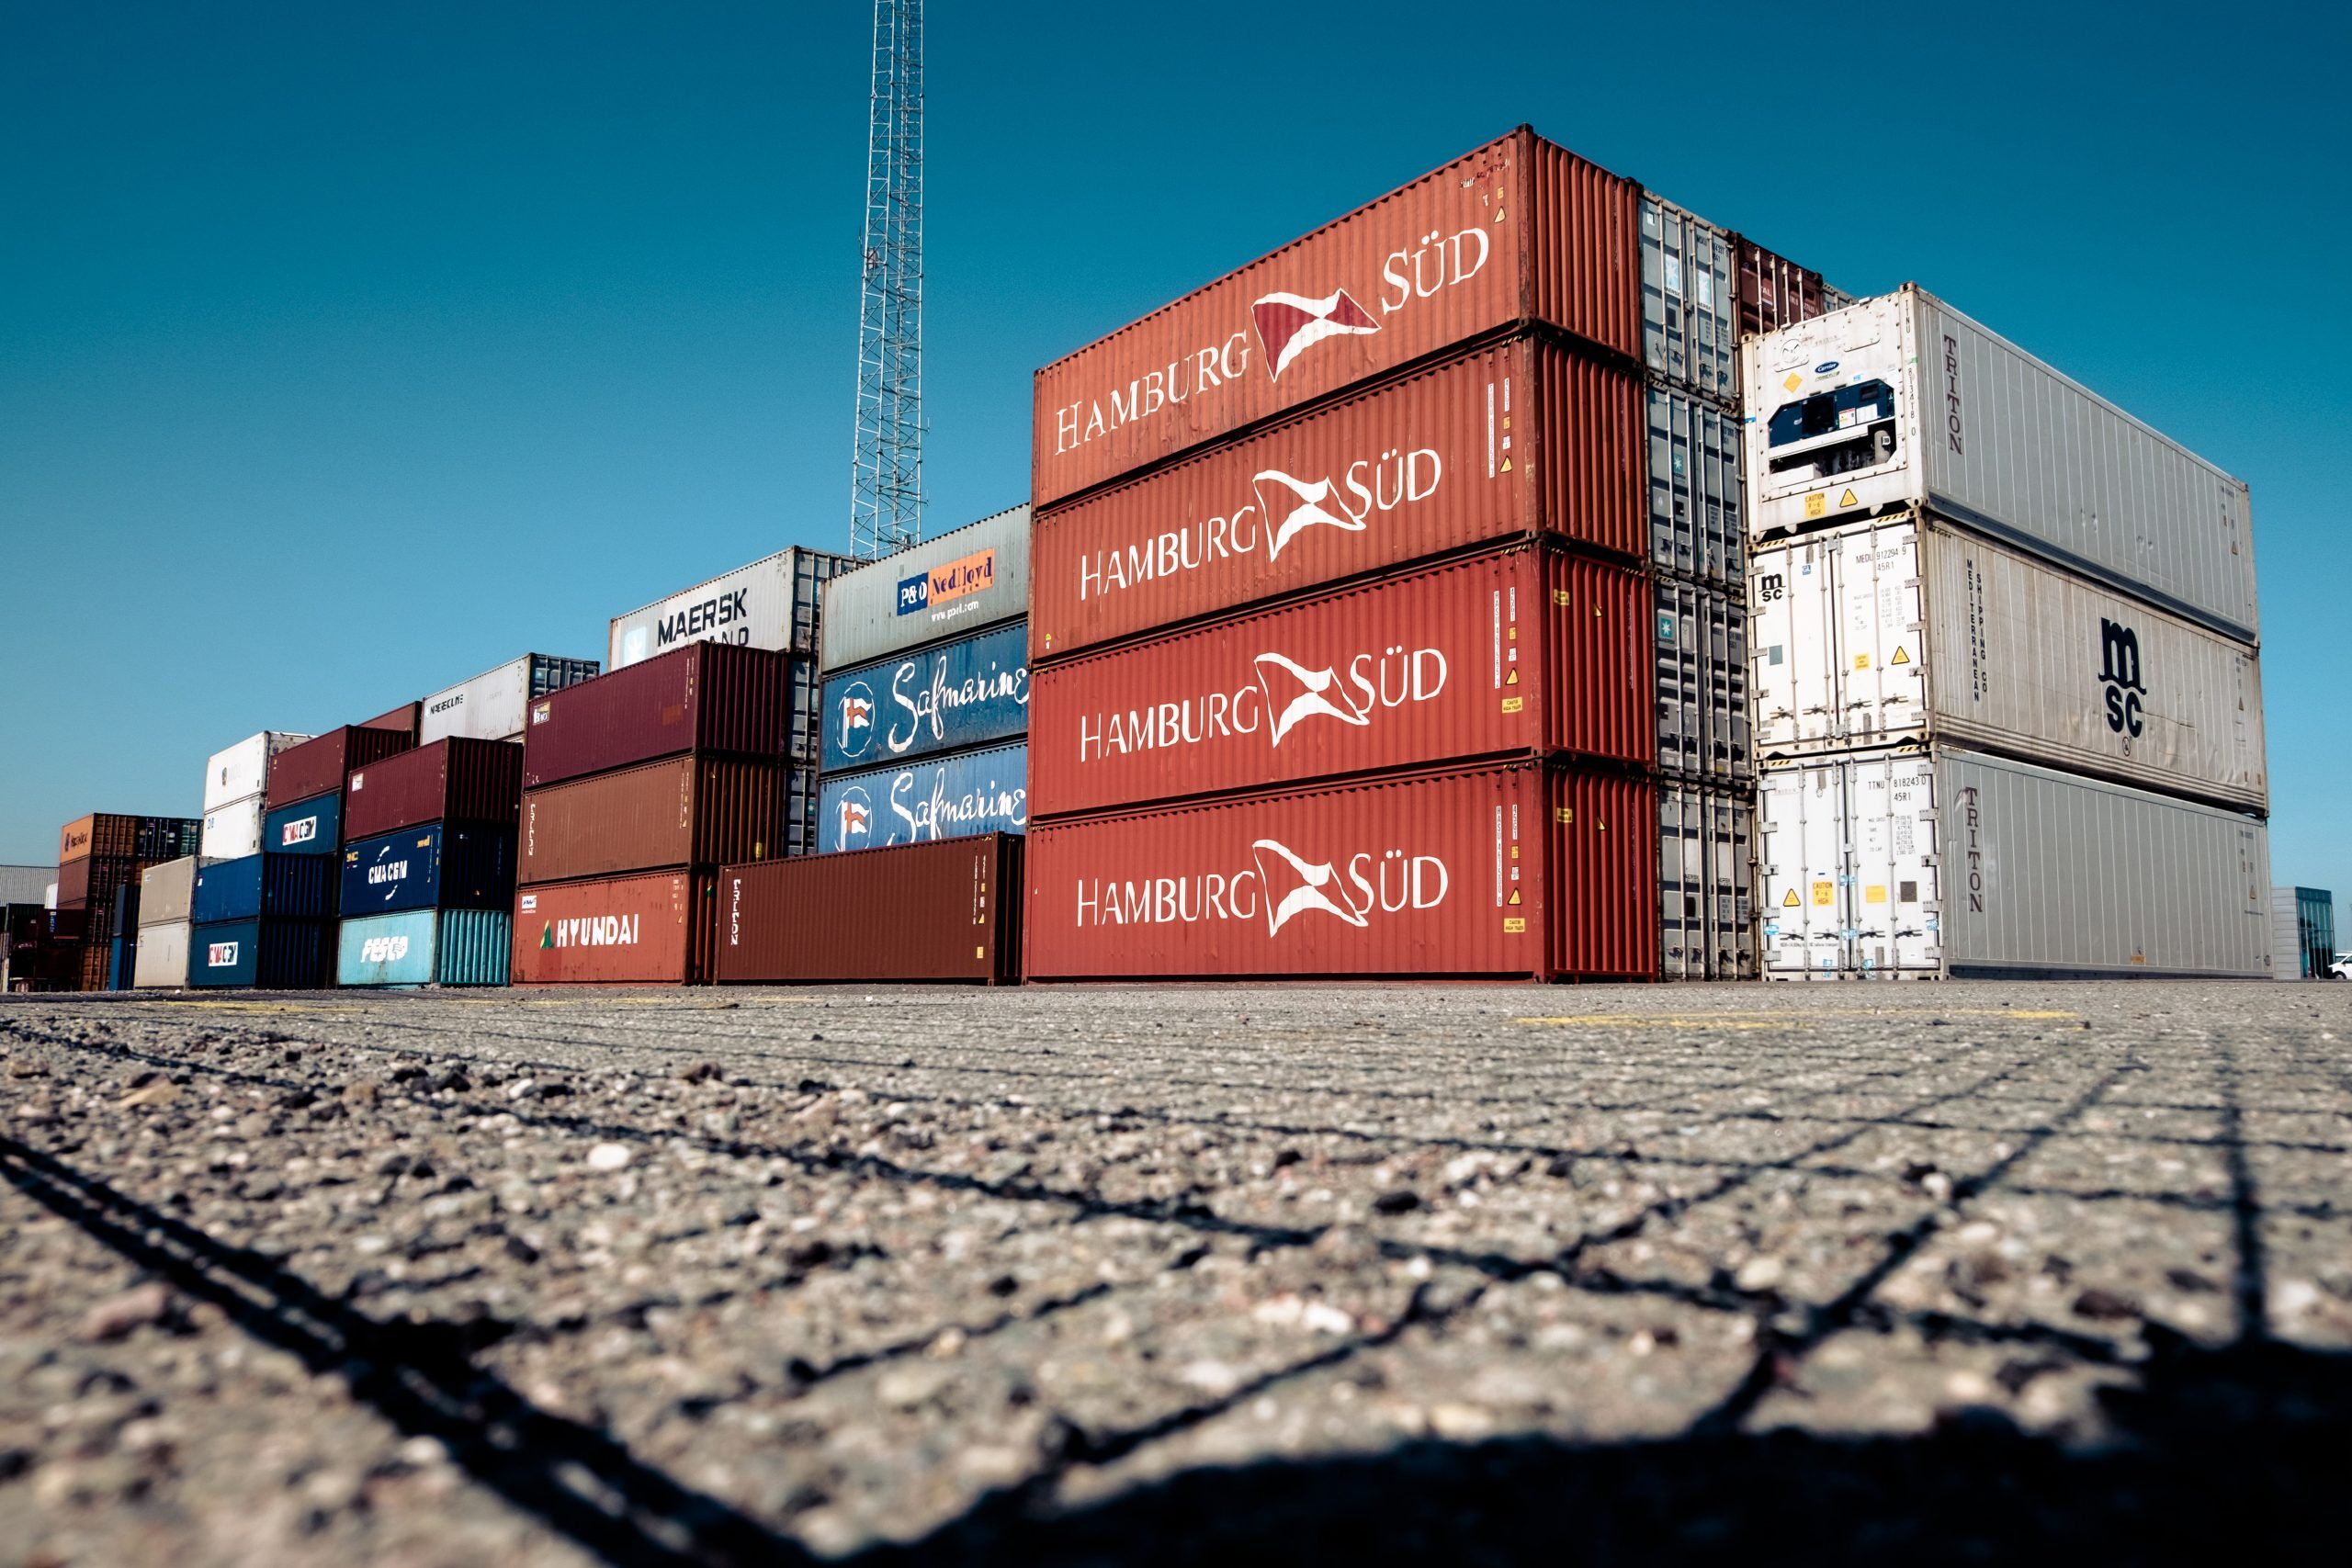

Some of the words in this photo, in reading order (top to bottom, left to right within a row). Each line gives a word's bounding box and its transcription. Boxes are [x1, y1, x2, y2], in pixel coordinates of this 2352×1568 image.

[1055, 329, 1250, 456] HAMBURG
[1381, 227, 1488, 316] SÜD
[1817, 362, 1837, 372] Carrier
[1943, 333, 1962, 456] TRITON
[1080, 505, 1257, 601] HAMBURG
[1344, 447, 1442, 519] SÜD
[1855, 555, 1873, 565] MEDU
[1876, 548, 1899, 560] 912294
[900, 581, 927, 607] P&O
[933, 557, 992, 595] Nedlloyd
[1877, 562, 1894, 571] 45R1
[658, 587, 747, 647] MAERSK
[1966, 558, 1980, 702] MEDITERRANEAN
[1976, 573, 1986, 660] SHIPPING
[1982, 671, 1987, 693] CO
[888, 655, 1029, 754] Safmarine
[1080, 685, 1258, 762] HAMBURG
[1350, 645, 1447, 715] SÜD
[888, 767, 1026, 847] Safmarine
[1868, 781, 1885, 791] TTNU
[1894, 776, 1919, 788] 818243
[1921, 775, 1927, 785] 0
[1894, 792, 1911, 801] 45R1
[368, 863, 386, 885] CMA
[388, 860, 408, 882] CGM
[1965, 786, 1983, 913] TRITON
[1077, 871, 1257, 928] HAMBURG
[1348, 850, 1448, 914] SÜD
[360, 935, 409, 964] FESCO
[556, 914, 639, 948] HYUNDAI
